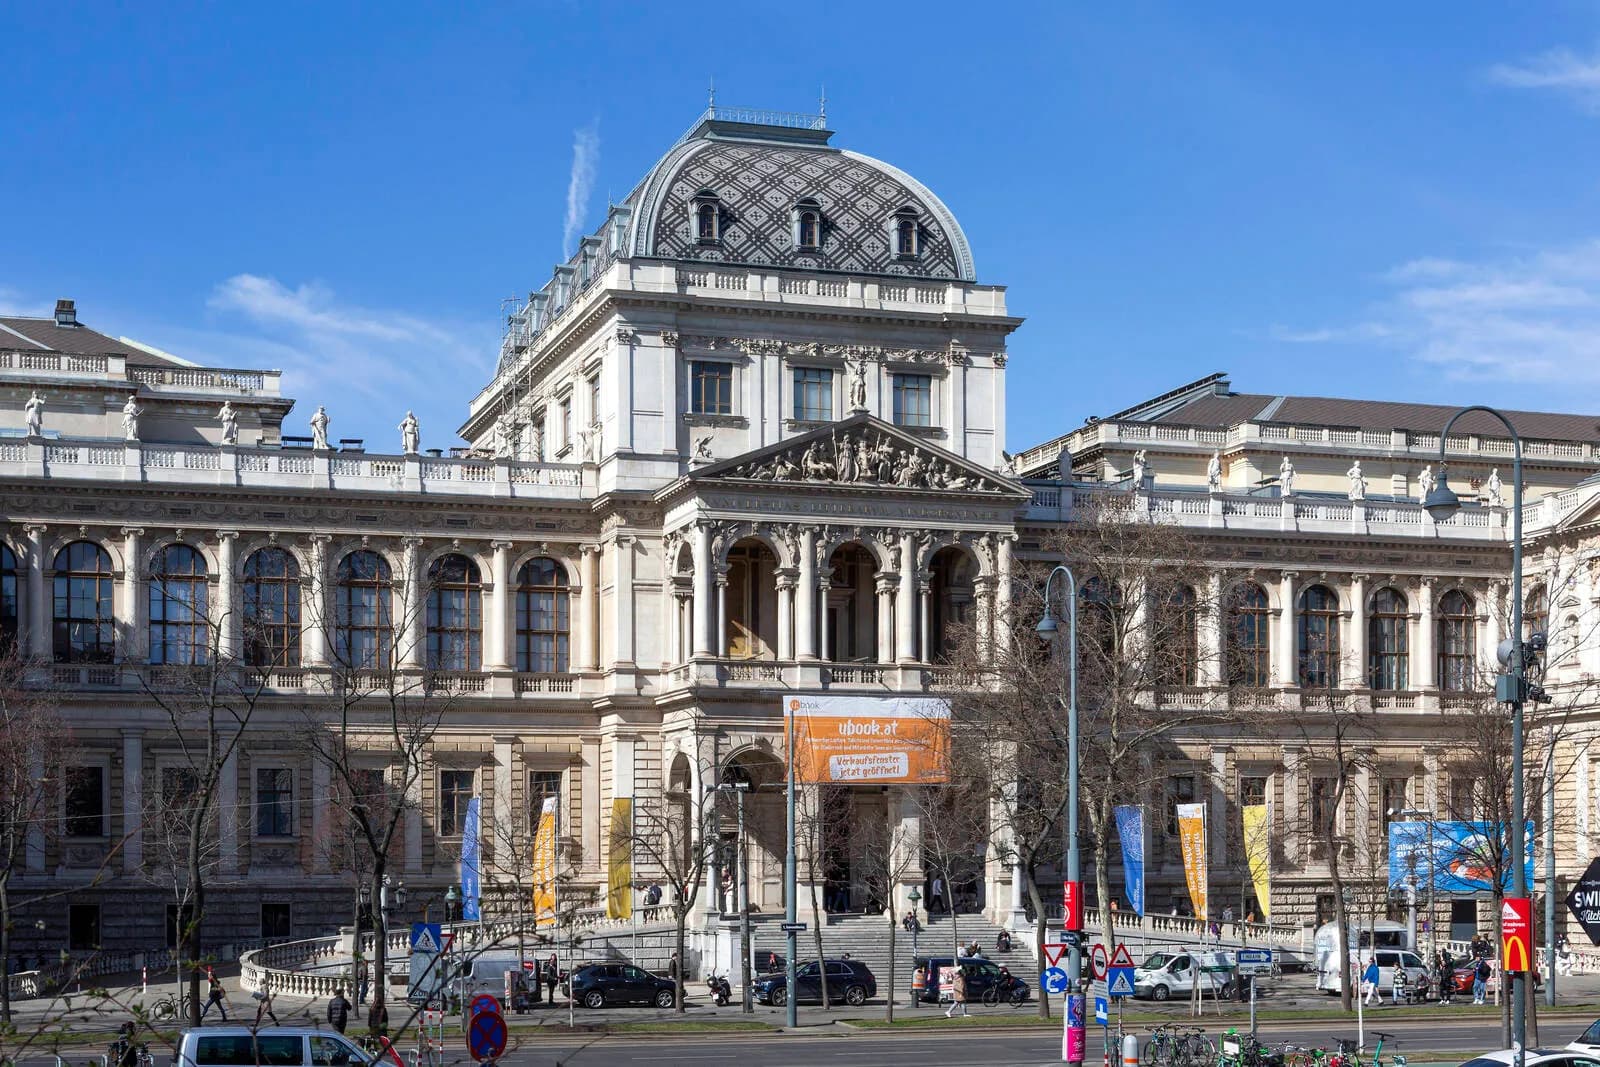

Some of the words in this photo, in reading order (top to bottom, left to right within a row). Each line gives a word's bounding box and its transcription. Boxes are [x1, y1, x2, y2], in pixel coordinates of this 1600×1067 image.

[838, 719, 898, 736] ubook.at
[836, 755, 901, 766] Verkaufsfenster
[839, 766, 860, 778] jetzt
[862, 765, 900, 777] geöffnet!
[1574, 891, 1600, 908] SWI
